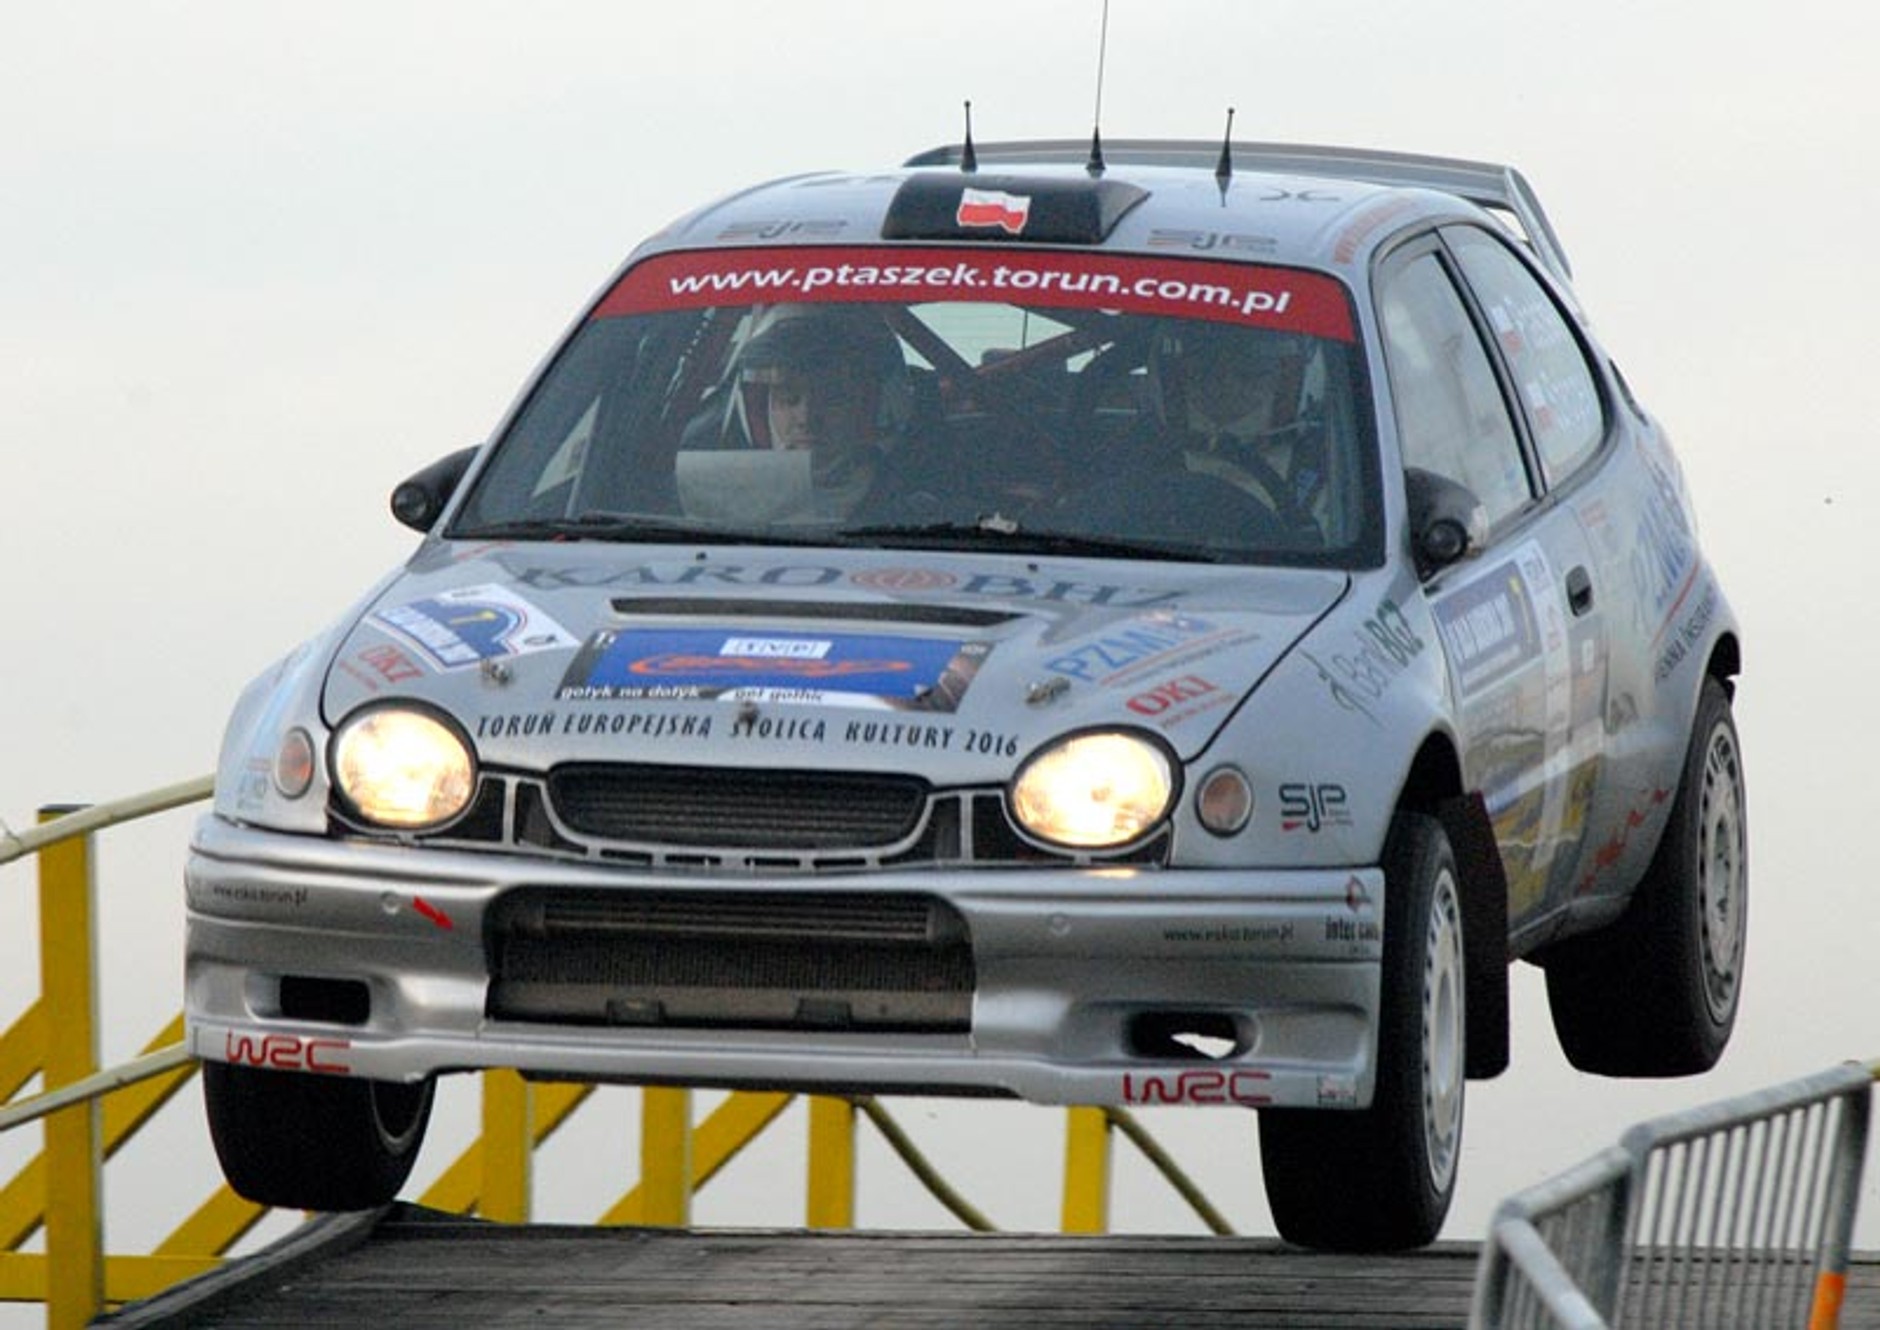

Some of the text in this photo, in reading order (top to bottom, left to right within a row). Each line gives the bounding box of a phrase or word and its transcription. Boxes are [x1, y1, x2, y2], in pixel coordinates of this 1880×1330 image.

[668, 262, 1293, 318] www.ptaszek.torun.com.pl
[561, 685, 699, 700] gotyk na dotyk
[563, 713, 713, 739] EUROPEJSKA
[729, 715, 828, 741] STOLICA
[845, 720, 955, 748] KULTURY
[965, 729, 1019, 756] 2016
[1278, 783, 1347, 833] SJP
[226, 1033, 351, 1073] WRC
[1122, 1071, 1272, 1104] WRC
